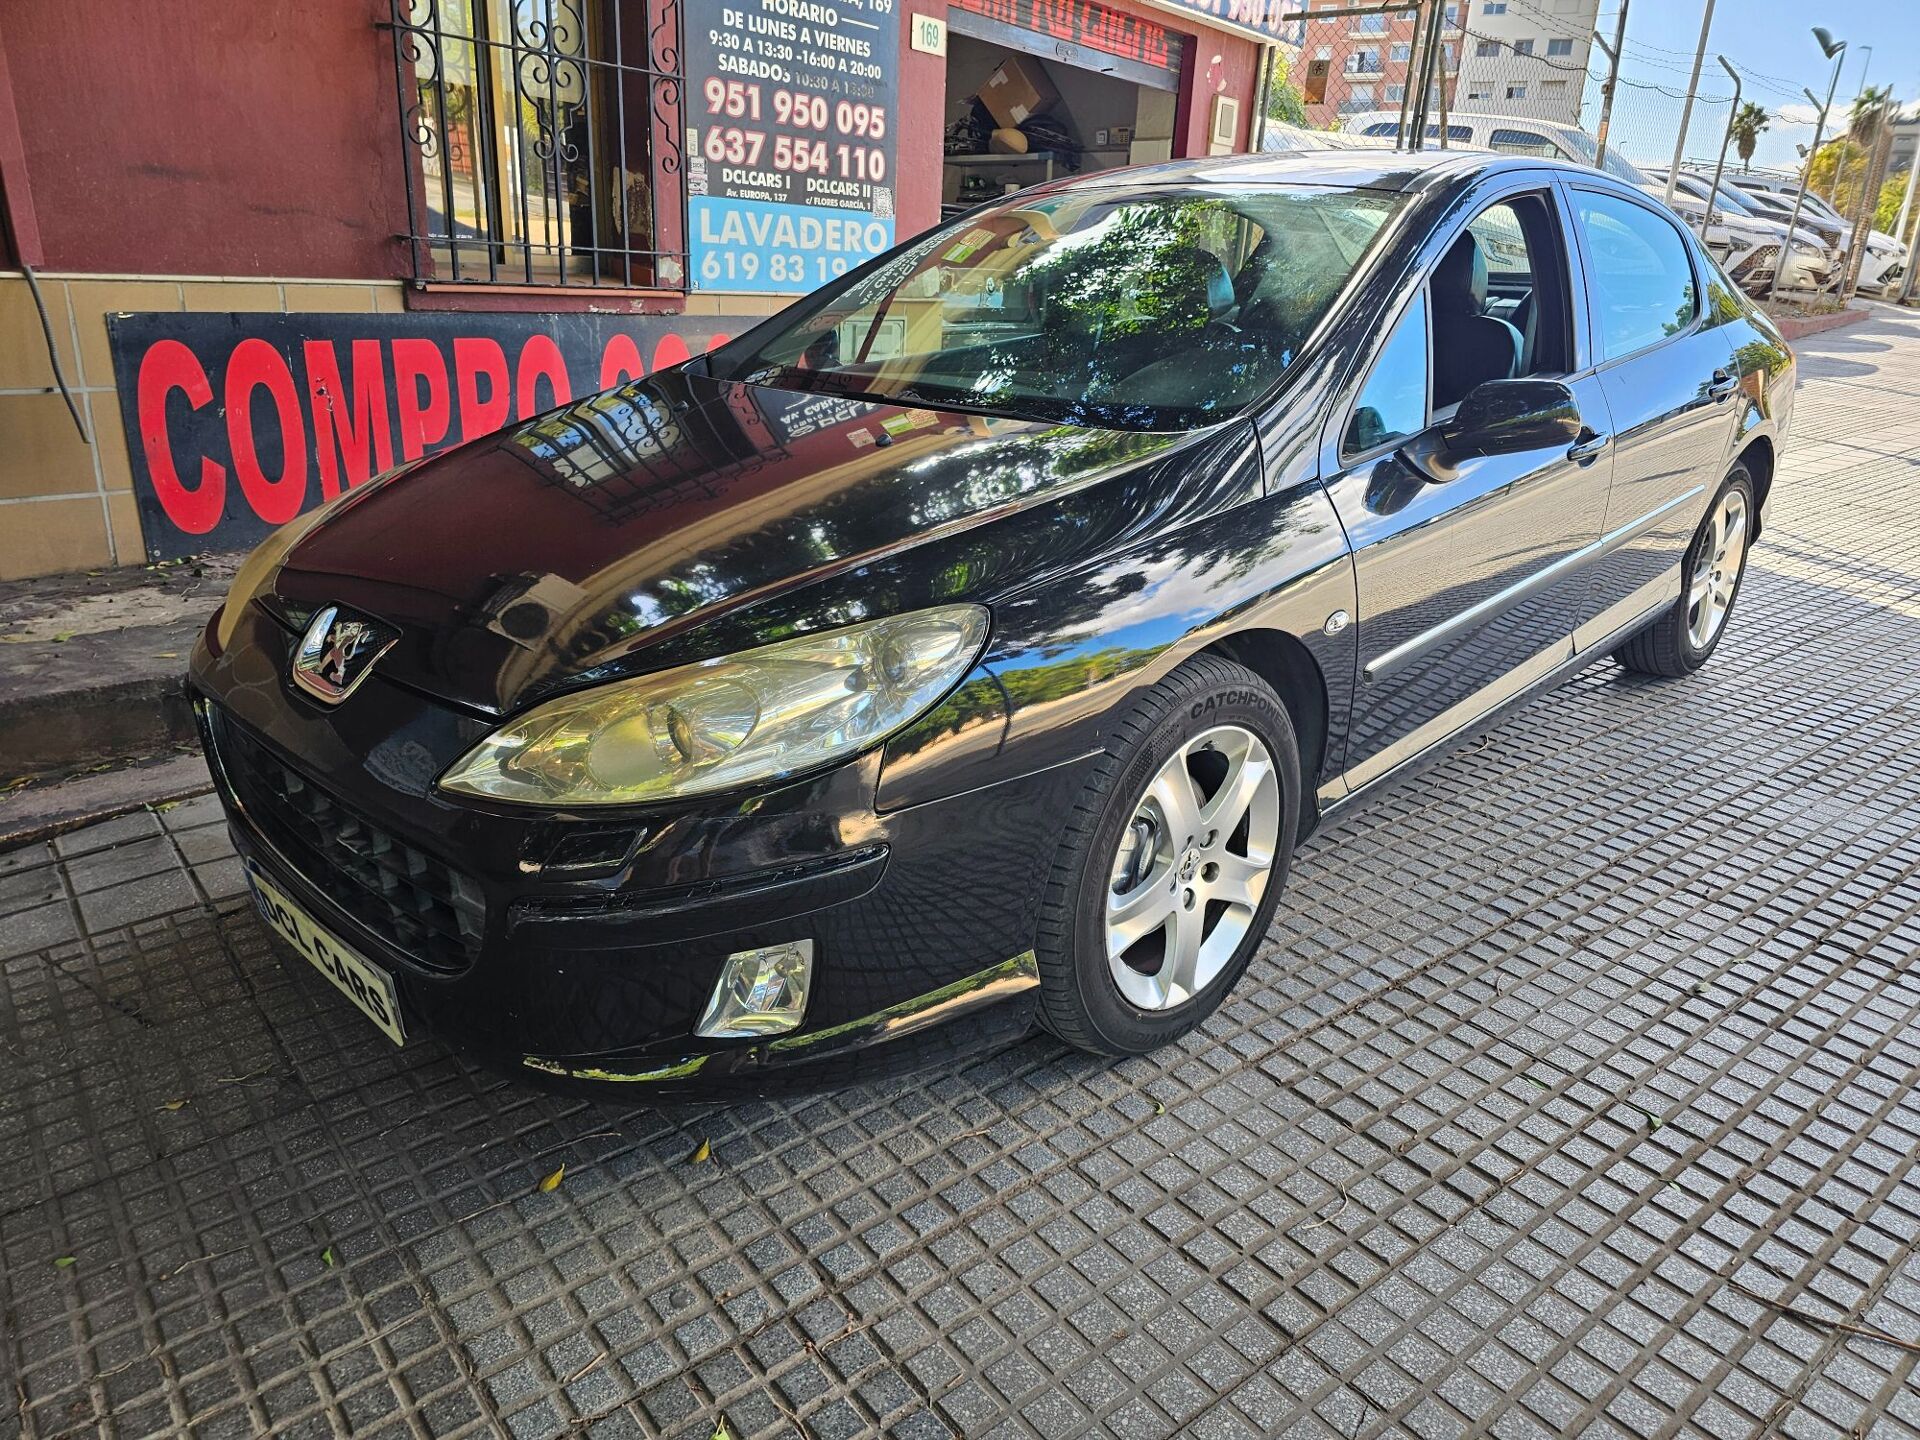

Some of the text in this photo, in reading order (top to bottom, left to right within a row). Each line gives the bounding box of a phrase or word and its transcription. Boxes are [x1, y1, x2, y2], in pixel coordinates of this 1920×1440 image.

[762, 0, 838, 27] HORARIO
[723, 8, 871, 58] DE LUNES A VIERNES
[920, 21, 939, 48] 169
[709, 30, 740, 50] 9:30
[743, 37, 753, 53] A
[757, 40, 793, 61] 13:30
[838, 58, 847, 73] A
[850, 62, 882, 79] 20:00
[718, 53, 791, 83] SABADOS
[704, 76, 886, 140] 951 950 095
[704, 126, 767, 167] 637
[773, 135, 829, 176] 554
[836, 144, 886, 183] 110
[722, 168, 783, 189] DCLCARS
[786, 175, 792, 189] I
[806, 178, 871, 198] DCLCARS II
[726, 188, 787, 202] Av. EUROPA, 137
[814, 197, 839, 208] FLORES
[700, 208, 888, 254] LAVADERO
[702, 251, 760, 281] 619
[770, 254, 805, 283] 83
[816, 256, 848, 283] 19
[1190, 690, 1289, 735] CATCHPOWER
[257, 886, 391, 1027] DCL CARS
